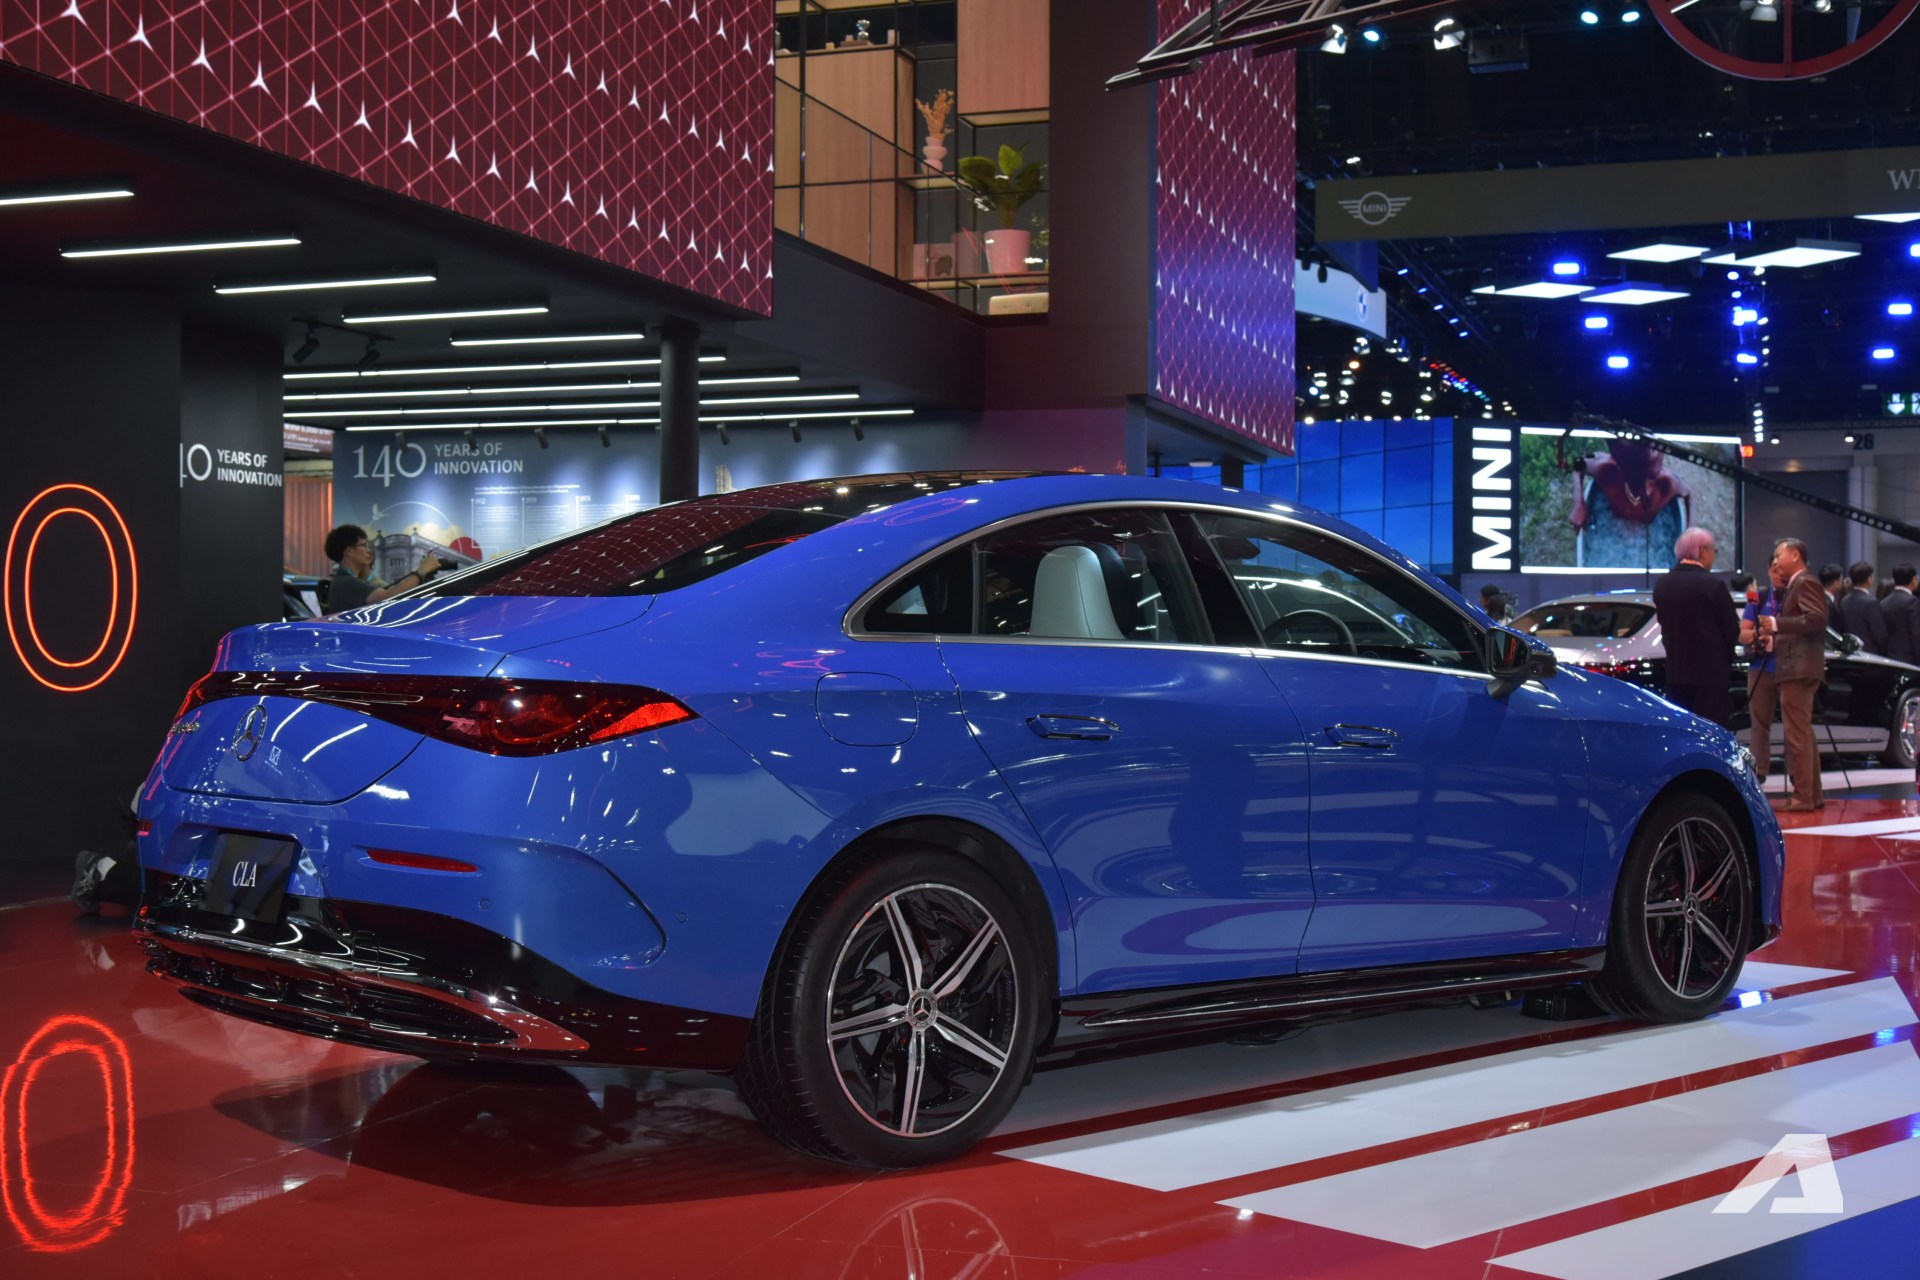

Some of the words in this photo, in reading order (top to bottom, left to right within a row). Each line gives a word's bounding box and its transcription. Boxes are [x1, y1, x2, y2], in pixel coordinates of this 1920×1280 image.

[1362, 203, 1387, 213] MINI
[434, 444, 480, 457] YEARS
[483, 442, 503, 456] OF
[1853, 433, 1875, 450] 26
[217, 449, 252, 466] YEARS
[253, 453, 268, 468] OF
[353, 443, 427, 487] 140
[434, 459, 523, 475] INNOVATION
[217, 467, 282, 487] INNOVATION
[1472, 427, 1512, 571] MINI
[232, 860, 257, 887] CLA
